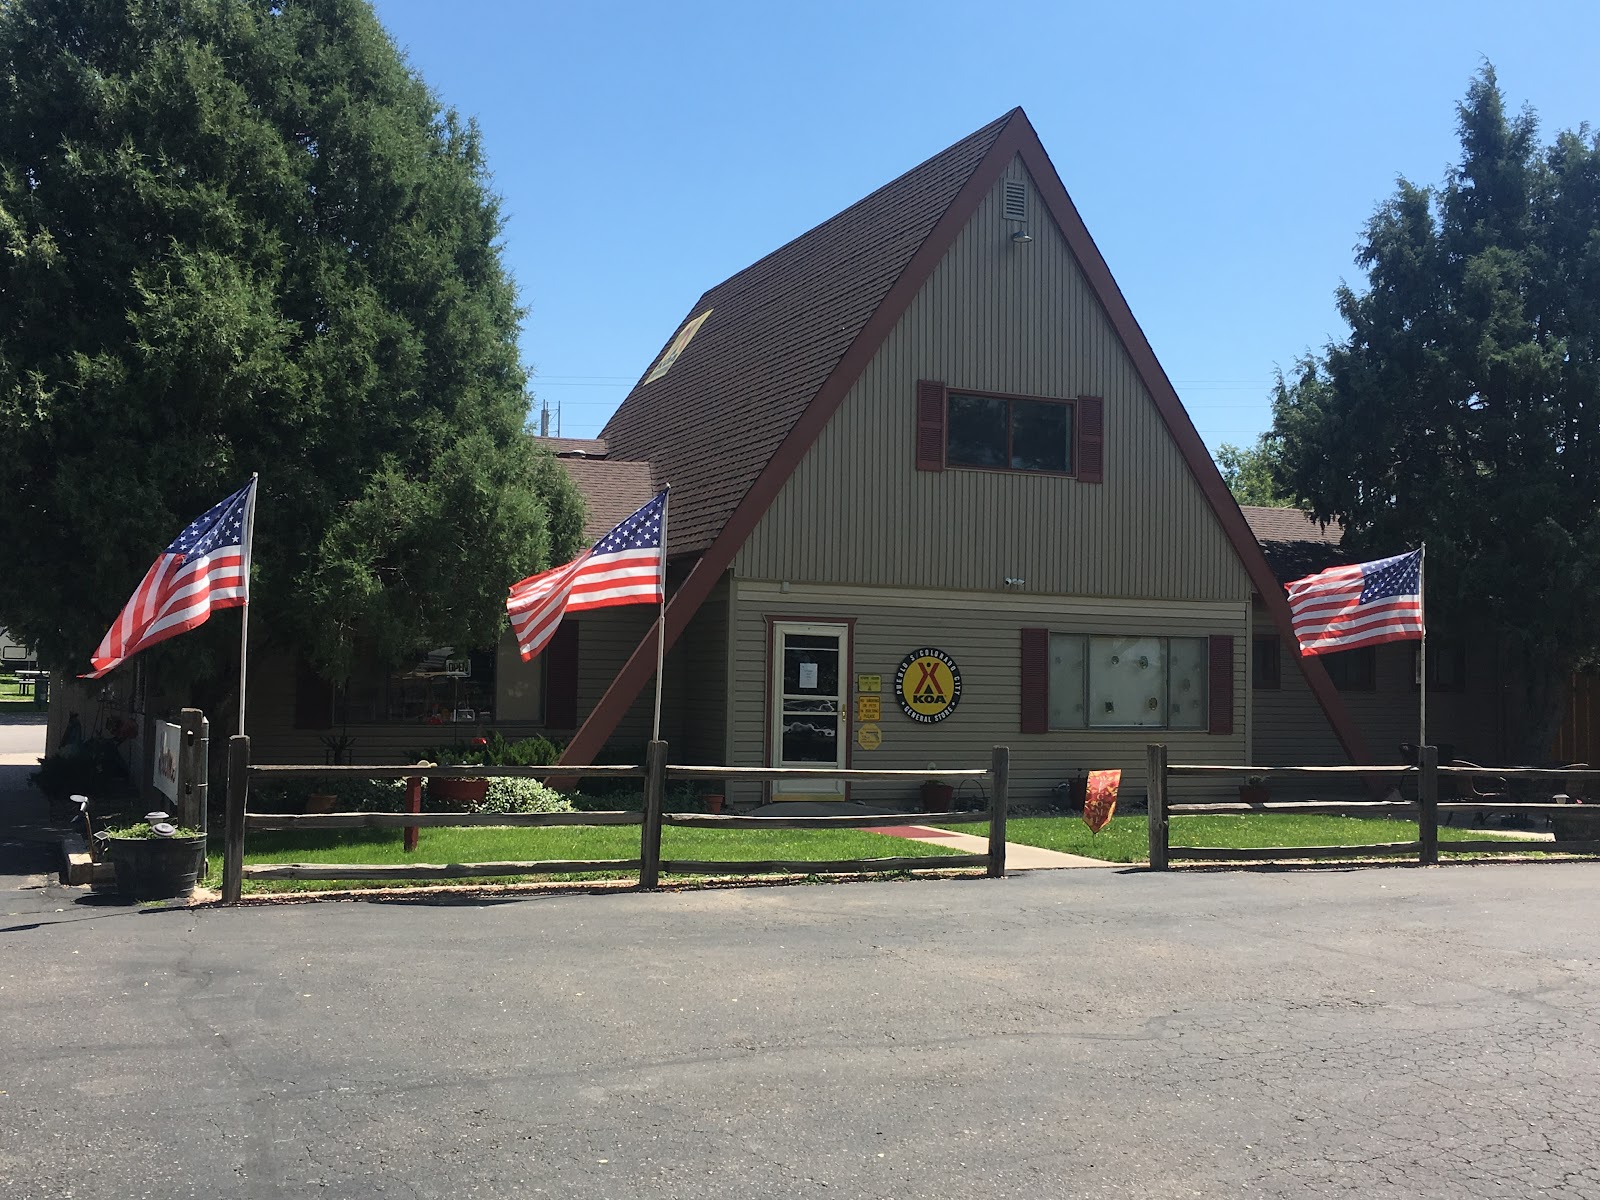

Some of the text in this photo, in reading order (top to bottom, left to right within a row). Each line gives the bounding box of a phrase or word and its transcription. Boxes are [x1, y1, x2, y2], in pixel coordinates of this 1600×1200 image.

[896, 662, 908, 695] PUEBLO
[913, 695, 946, 704] KOA
[904, 705, 953, 723] GENERAL STORE
